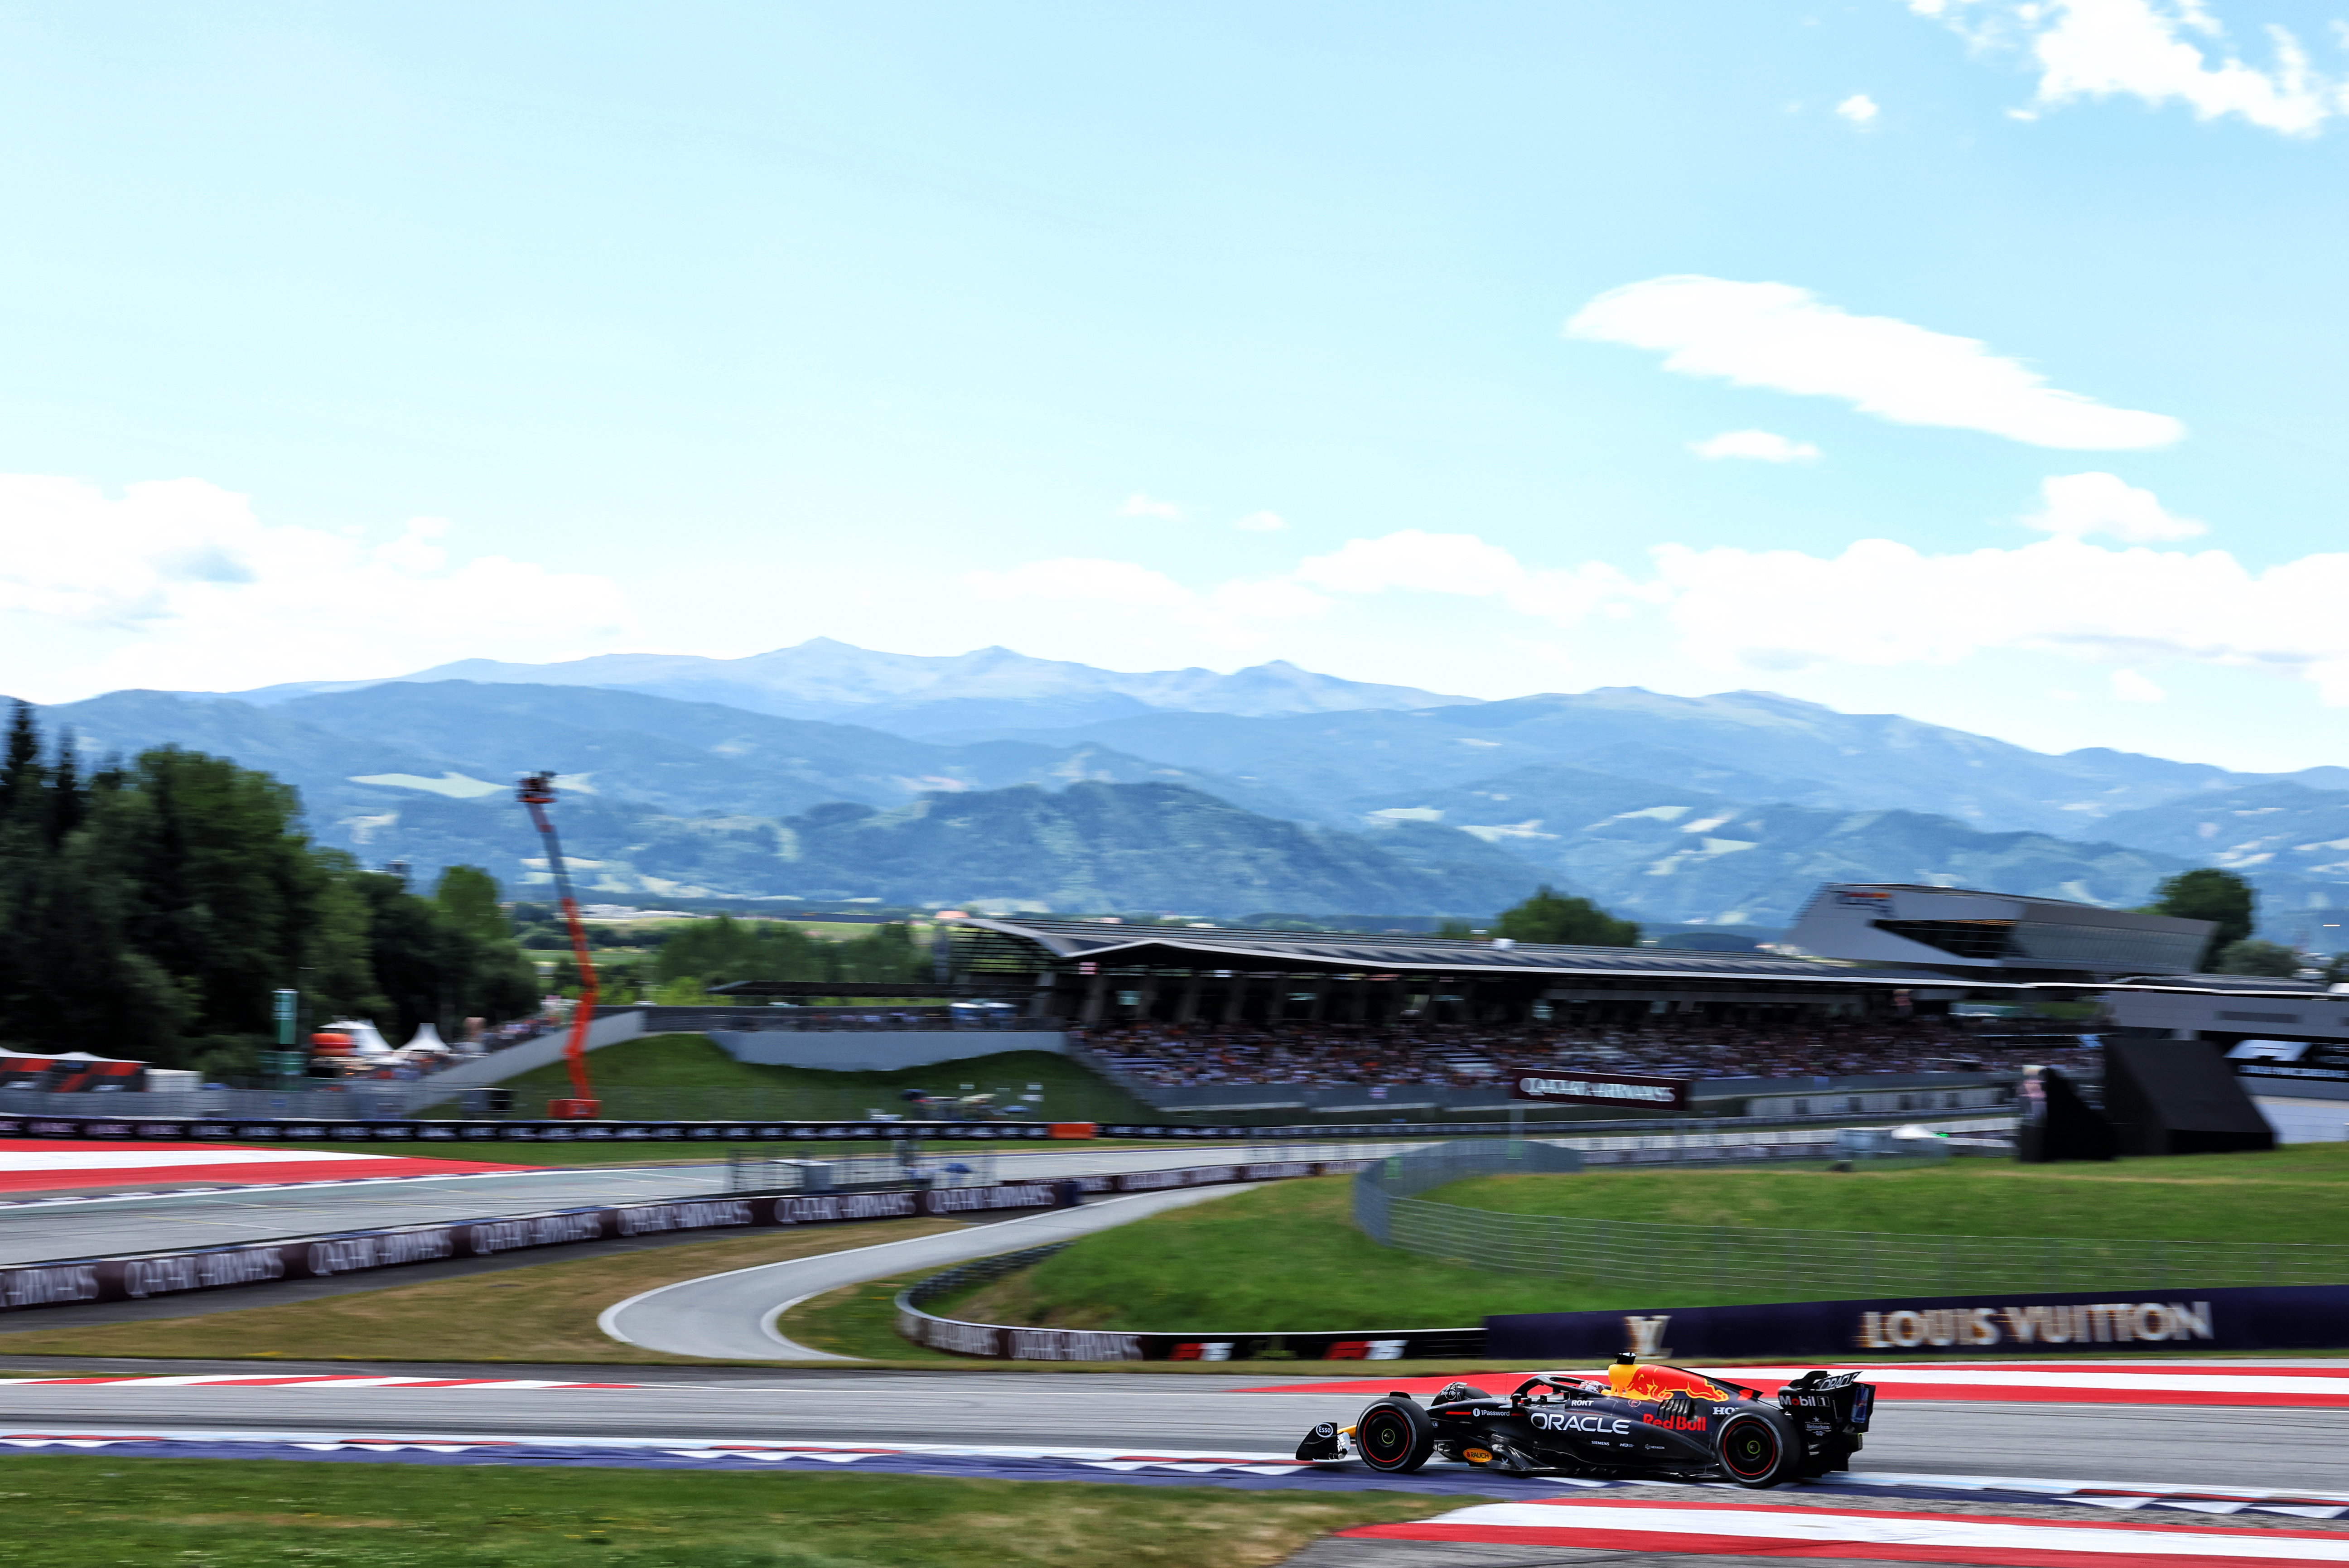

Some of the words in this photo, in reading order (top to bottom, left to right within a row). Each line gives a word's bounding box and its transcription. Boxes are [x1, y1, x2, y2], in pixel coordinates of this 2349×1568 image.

[1859, 1307, 2002, 1348] LOUIS
[2001, 1301, 2215, 1344] VUITTON
[1779, 1395, 1816, 1407] Mobil
[1820, 1397, 1826, 1406] 1
[1712, 1407, 1740, 1415] HO
[1530, 1413, 1632, 1435] ORACLE
[1642, 1413, 1675, 1429] Red
[1676, 1416, 1707, 1431] Bull
